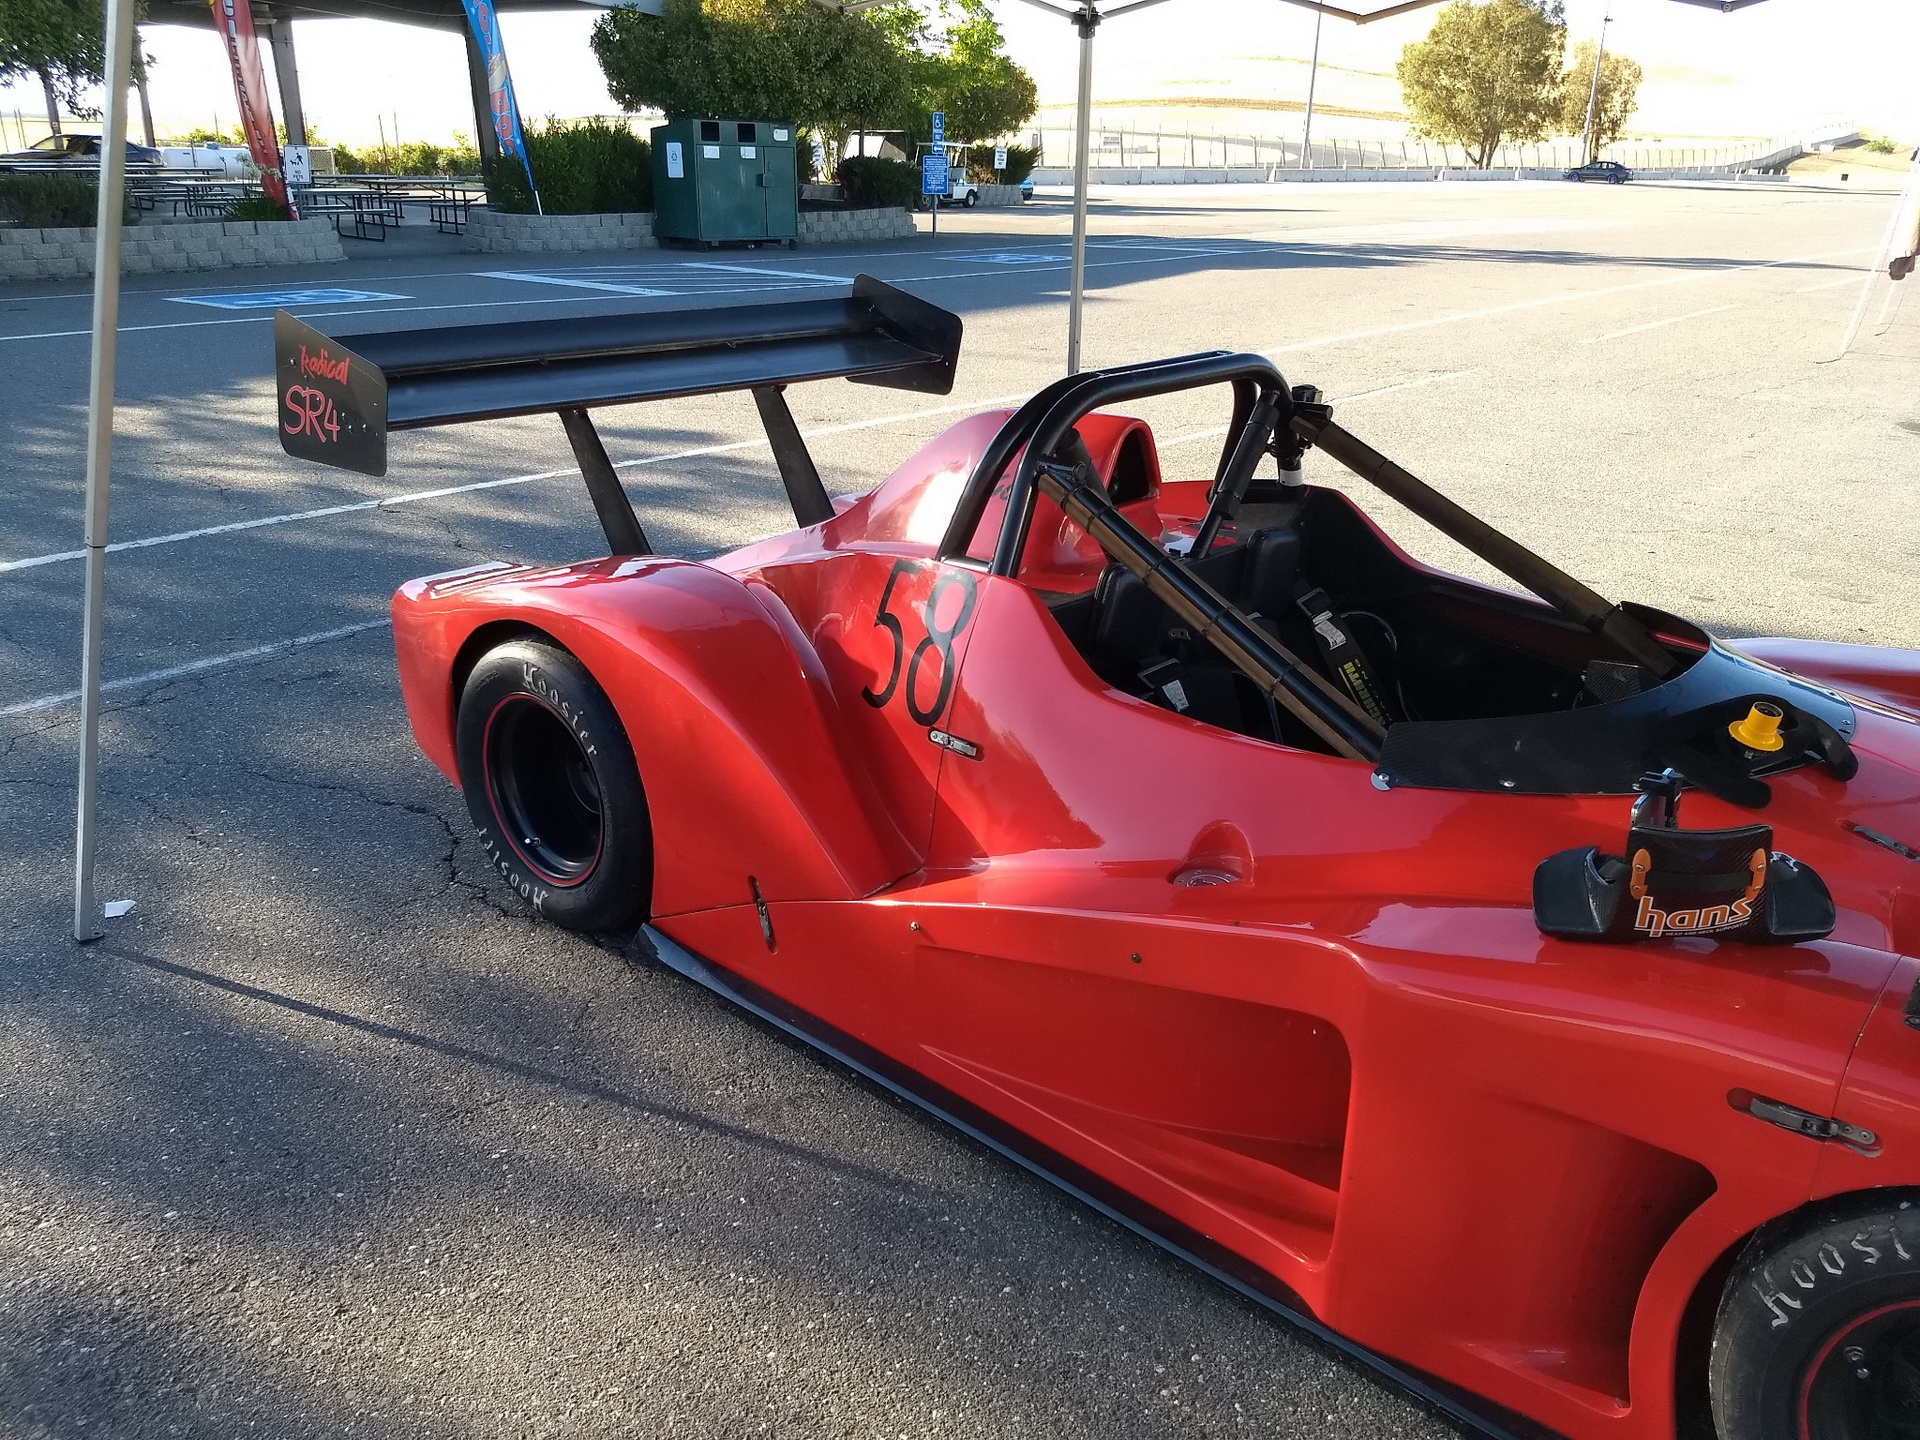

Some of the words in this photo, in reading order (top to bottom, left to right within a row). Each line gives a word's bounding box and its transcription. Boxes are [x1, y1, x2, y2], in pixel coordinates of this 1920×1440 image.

[299, 344, 350, 386] Radical
[284, 384, 341, 443] SR4
[861, 558, 977, 727] 58
[1634, 895, 1752, 938] hans
